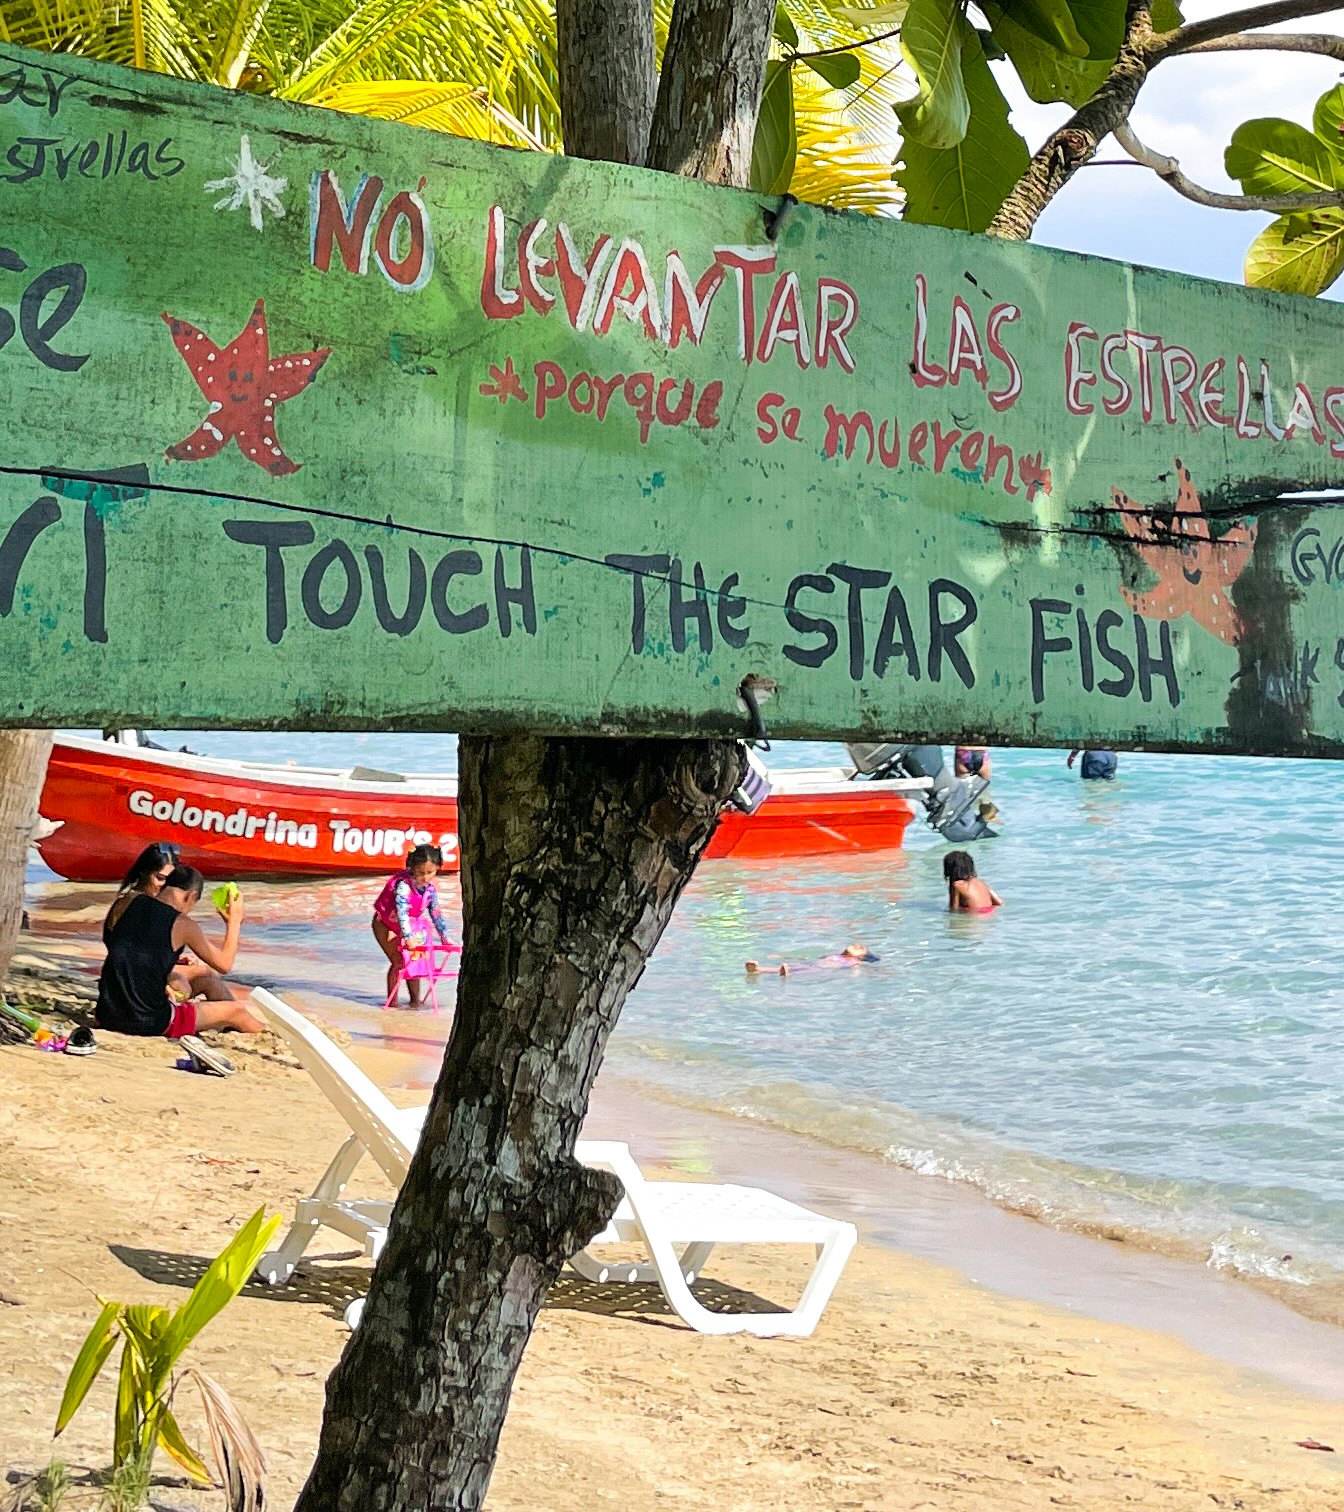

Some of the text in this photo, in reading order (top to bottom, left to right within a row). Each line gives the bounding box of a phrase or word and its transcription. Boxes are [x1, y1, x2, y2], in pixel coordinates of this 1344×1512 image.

[481, 204, 857, 374] LEVANTAR
[910, 273, 1023, 413] LAS
[221, 520, 537, 644] TOUCH
[604, 553, 750, 656] THE
[782, 563, 976, 688] STAR
[128, 789, 318, 849] Golondrina
